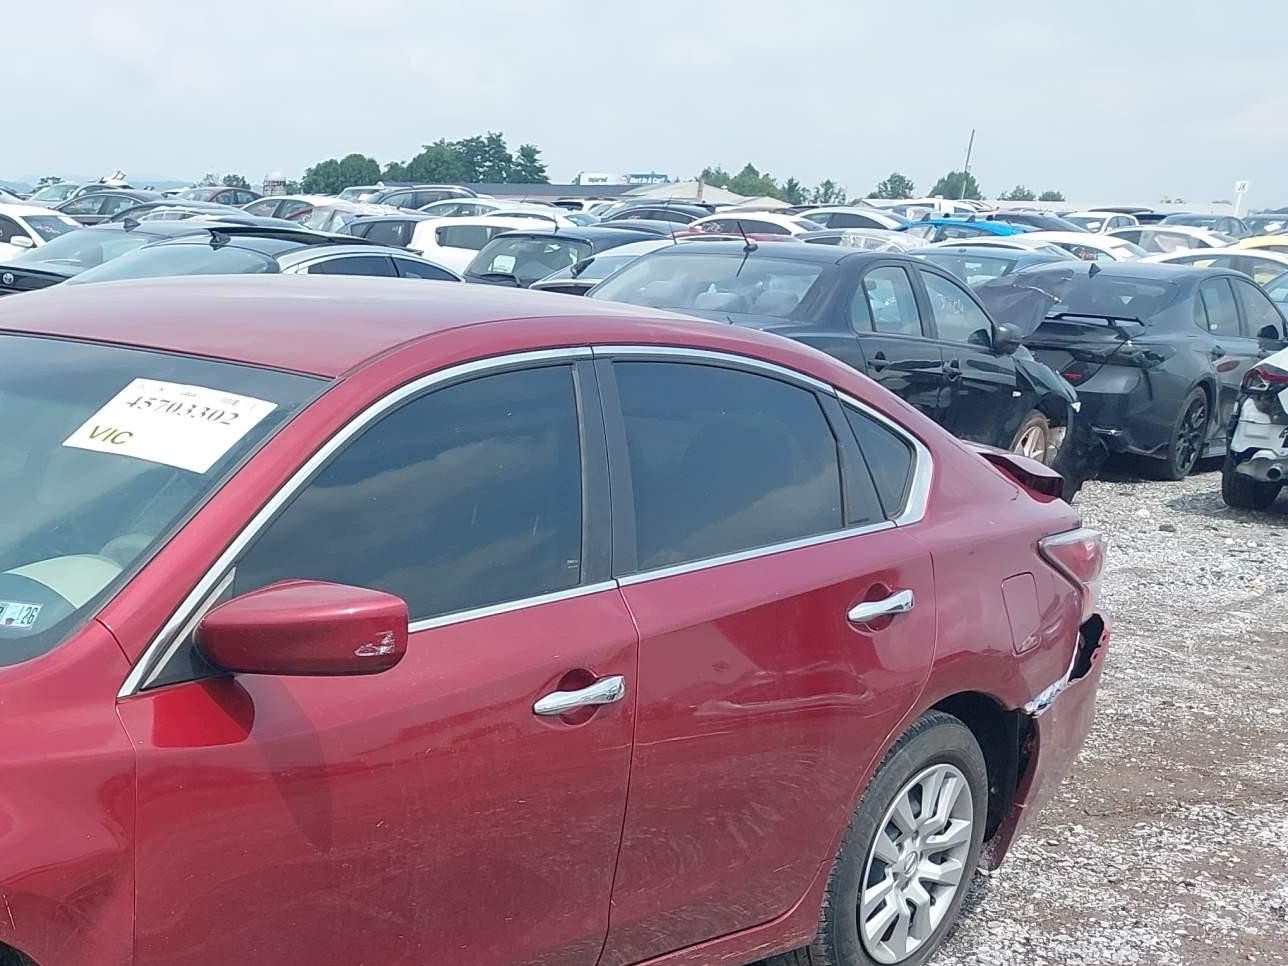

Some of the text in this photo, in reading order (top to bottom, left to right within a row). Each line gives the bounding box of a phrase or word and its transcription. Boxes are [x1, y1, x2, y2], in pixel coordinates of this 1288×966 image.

[125, 396, 239, 425] 45703302
[88, 424, 133, 445] VIC
[20, 606, 39, 624] 26
